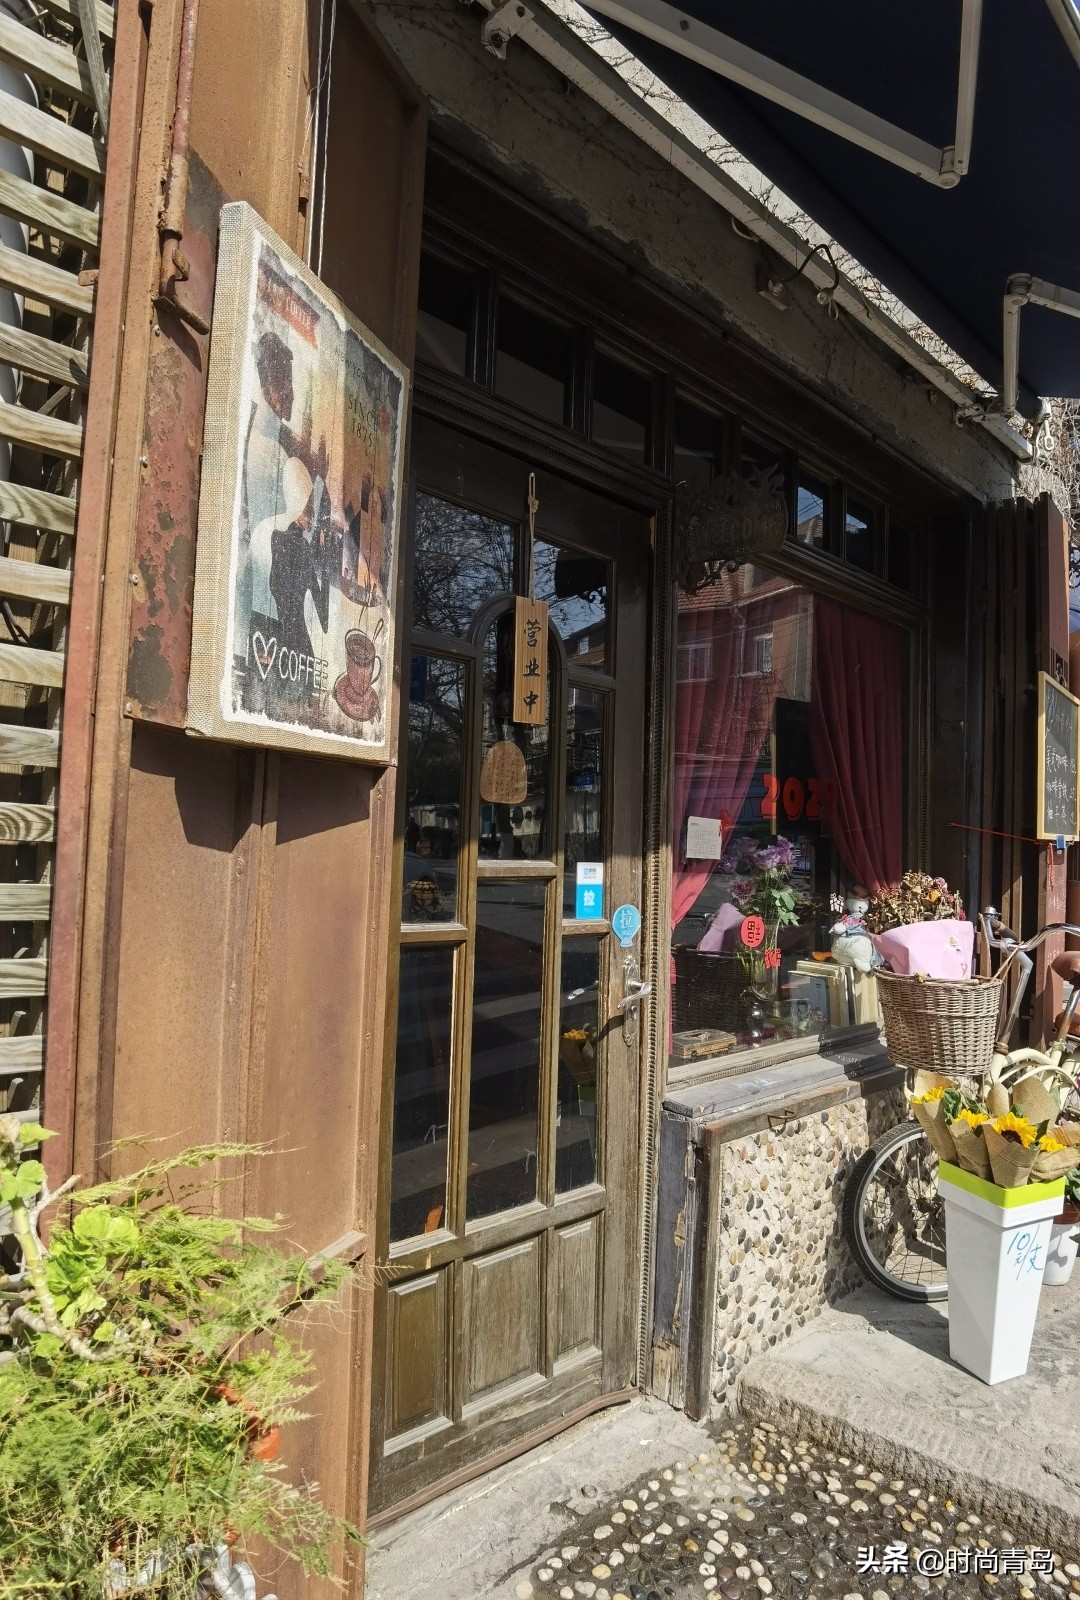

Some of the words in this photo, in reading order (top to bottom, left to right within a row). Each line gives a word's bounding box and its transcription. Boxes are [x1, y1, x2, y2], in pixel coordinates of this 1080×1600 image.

[347, 394, 379, 433] SINCE
[352, 416, 374, 448] 1875
[278, 646, 329, 691] COFFEE
[523, 618, 542, 715] 营业中
[620, 909, 634, 929] 拉
